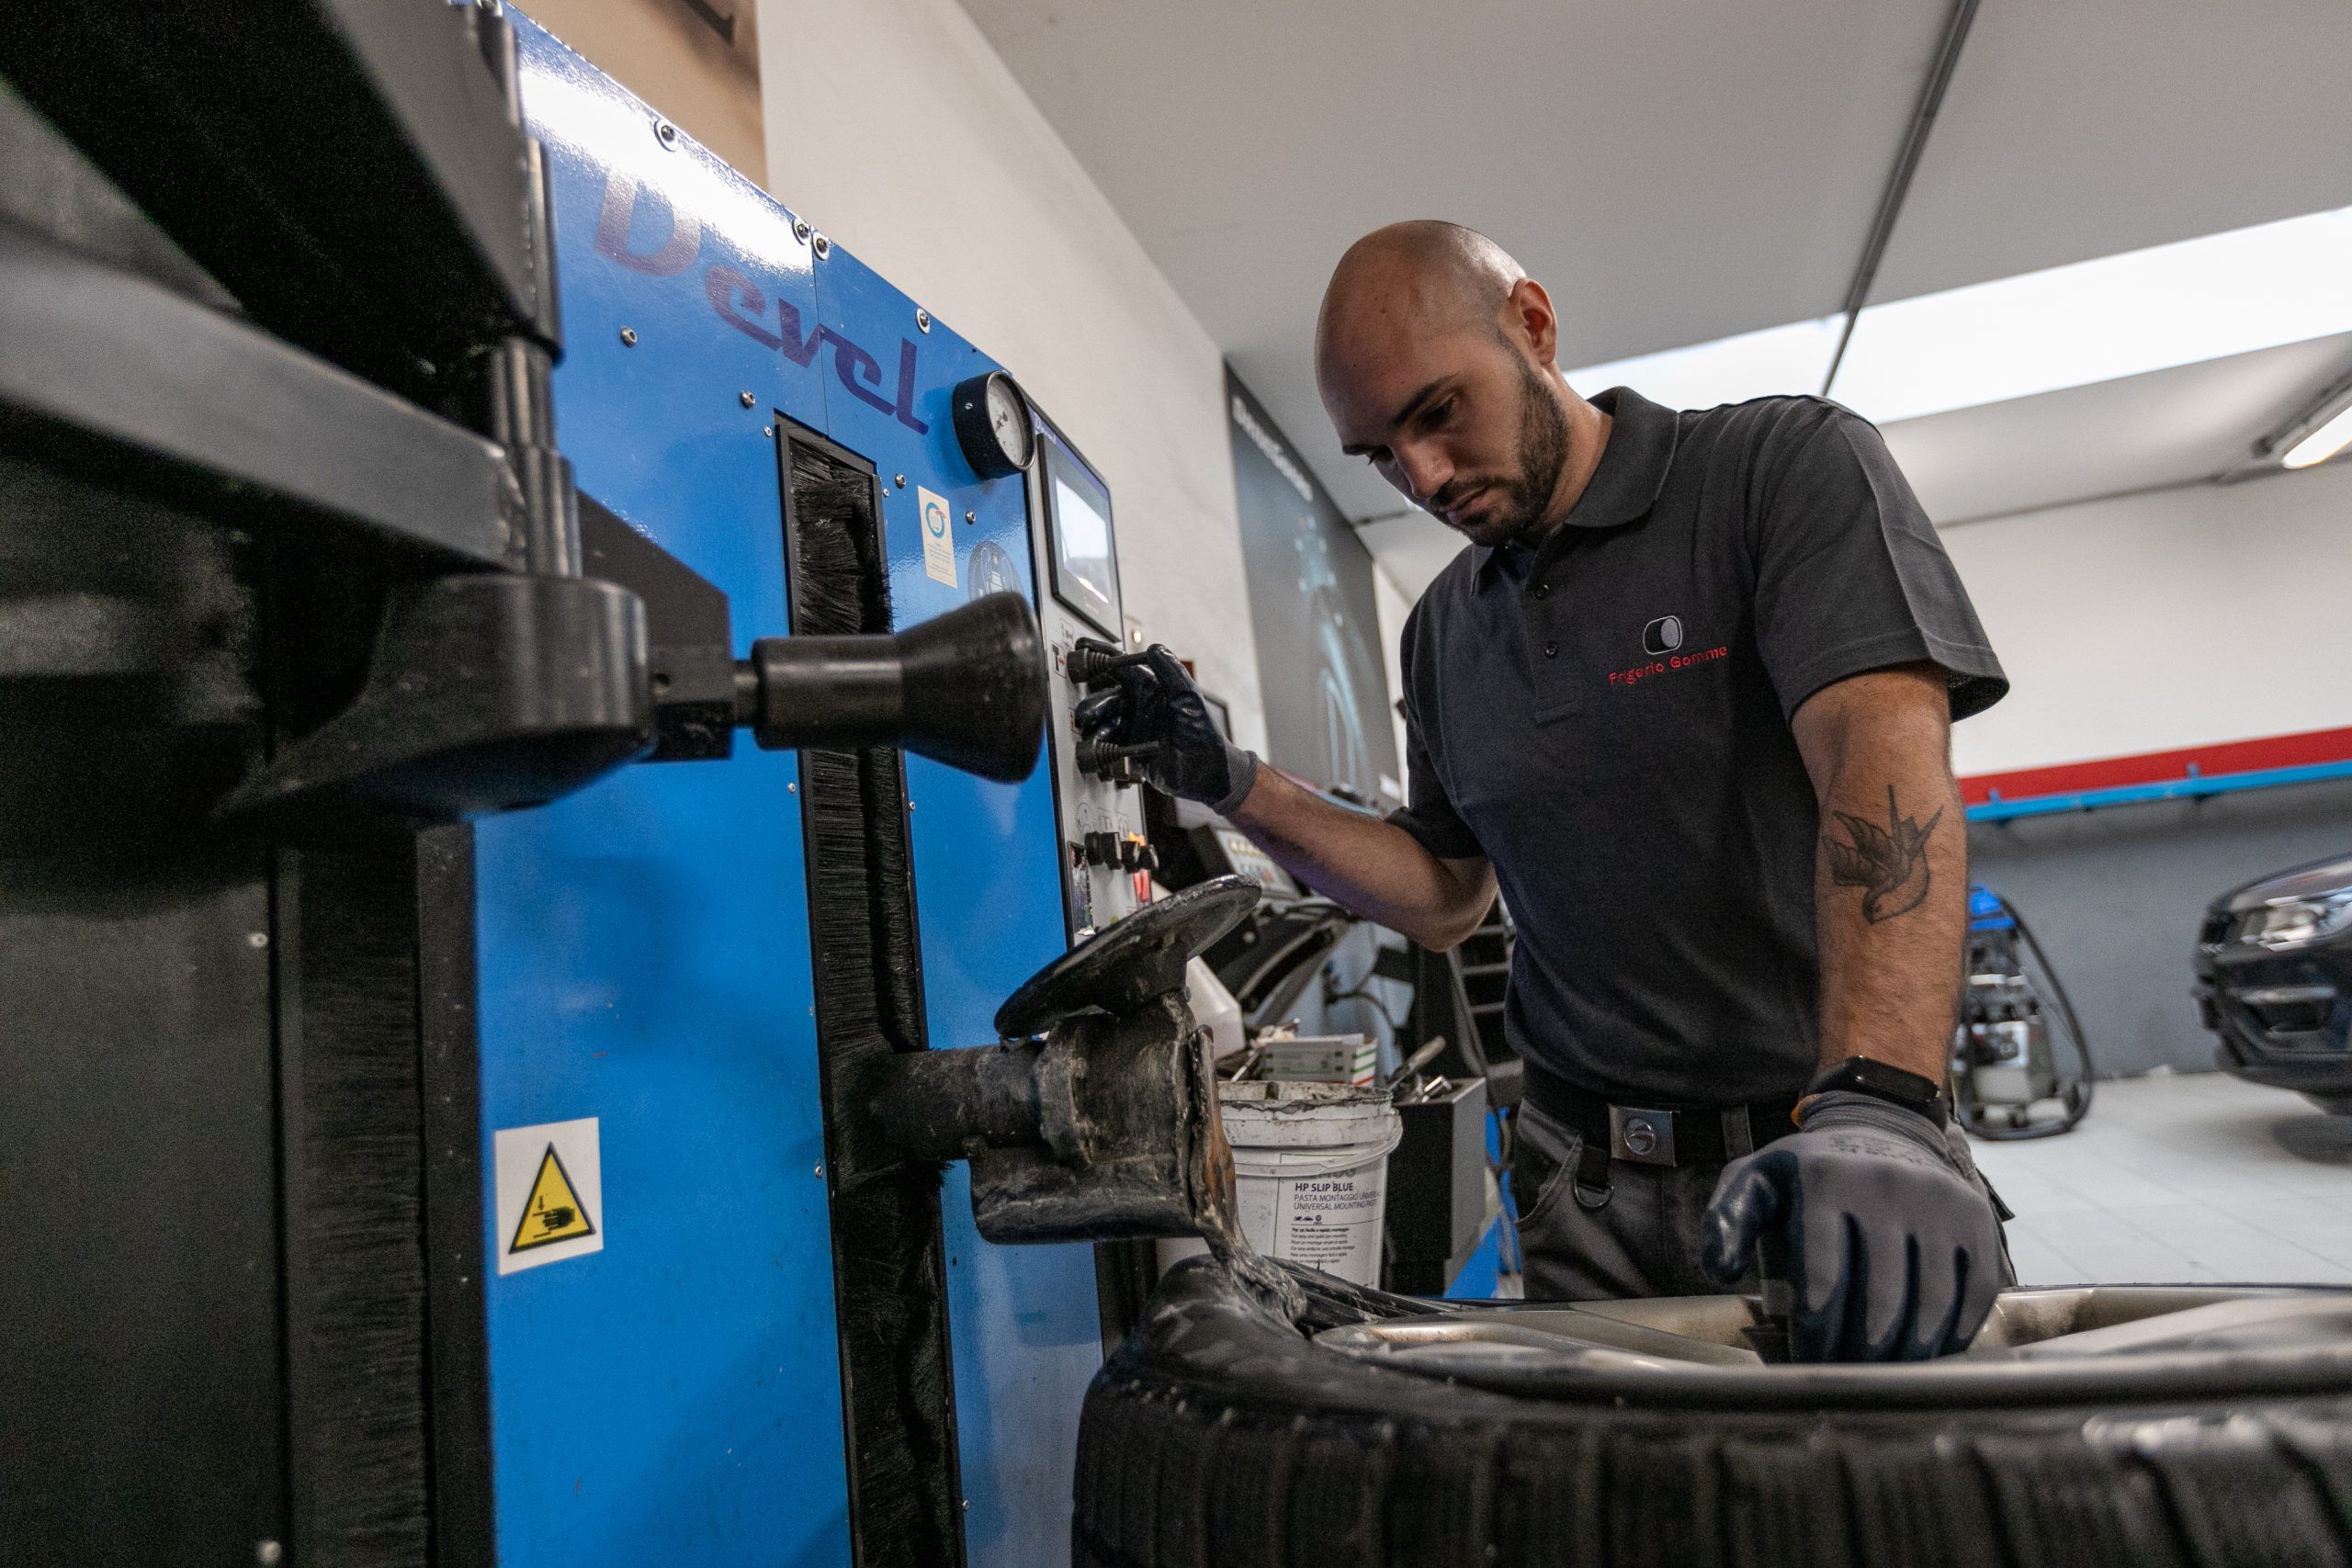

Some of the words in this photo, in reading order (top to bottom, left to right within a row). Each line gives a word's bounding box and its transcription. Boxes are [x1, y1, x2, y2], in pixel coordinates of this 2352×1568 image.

[1608, 661, 1665, 684] Frigerio
[1669, 646, 1727, 669] Gomme
[1295, 1182, 1309, 1191] HP
[1311, 1182, 1331, 1192] SLIP
[1332, 1182, 1353, 1191] BLUE
[1294, 1194, 1317, 1202] PASTA
[1319, 1192, 1358, 1202] MONTAGGIO
[1294, 1202, 1332, 1211] UNIVERSAL
[1334, 1200, 1365, 1210] MOUNTING
